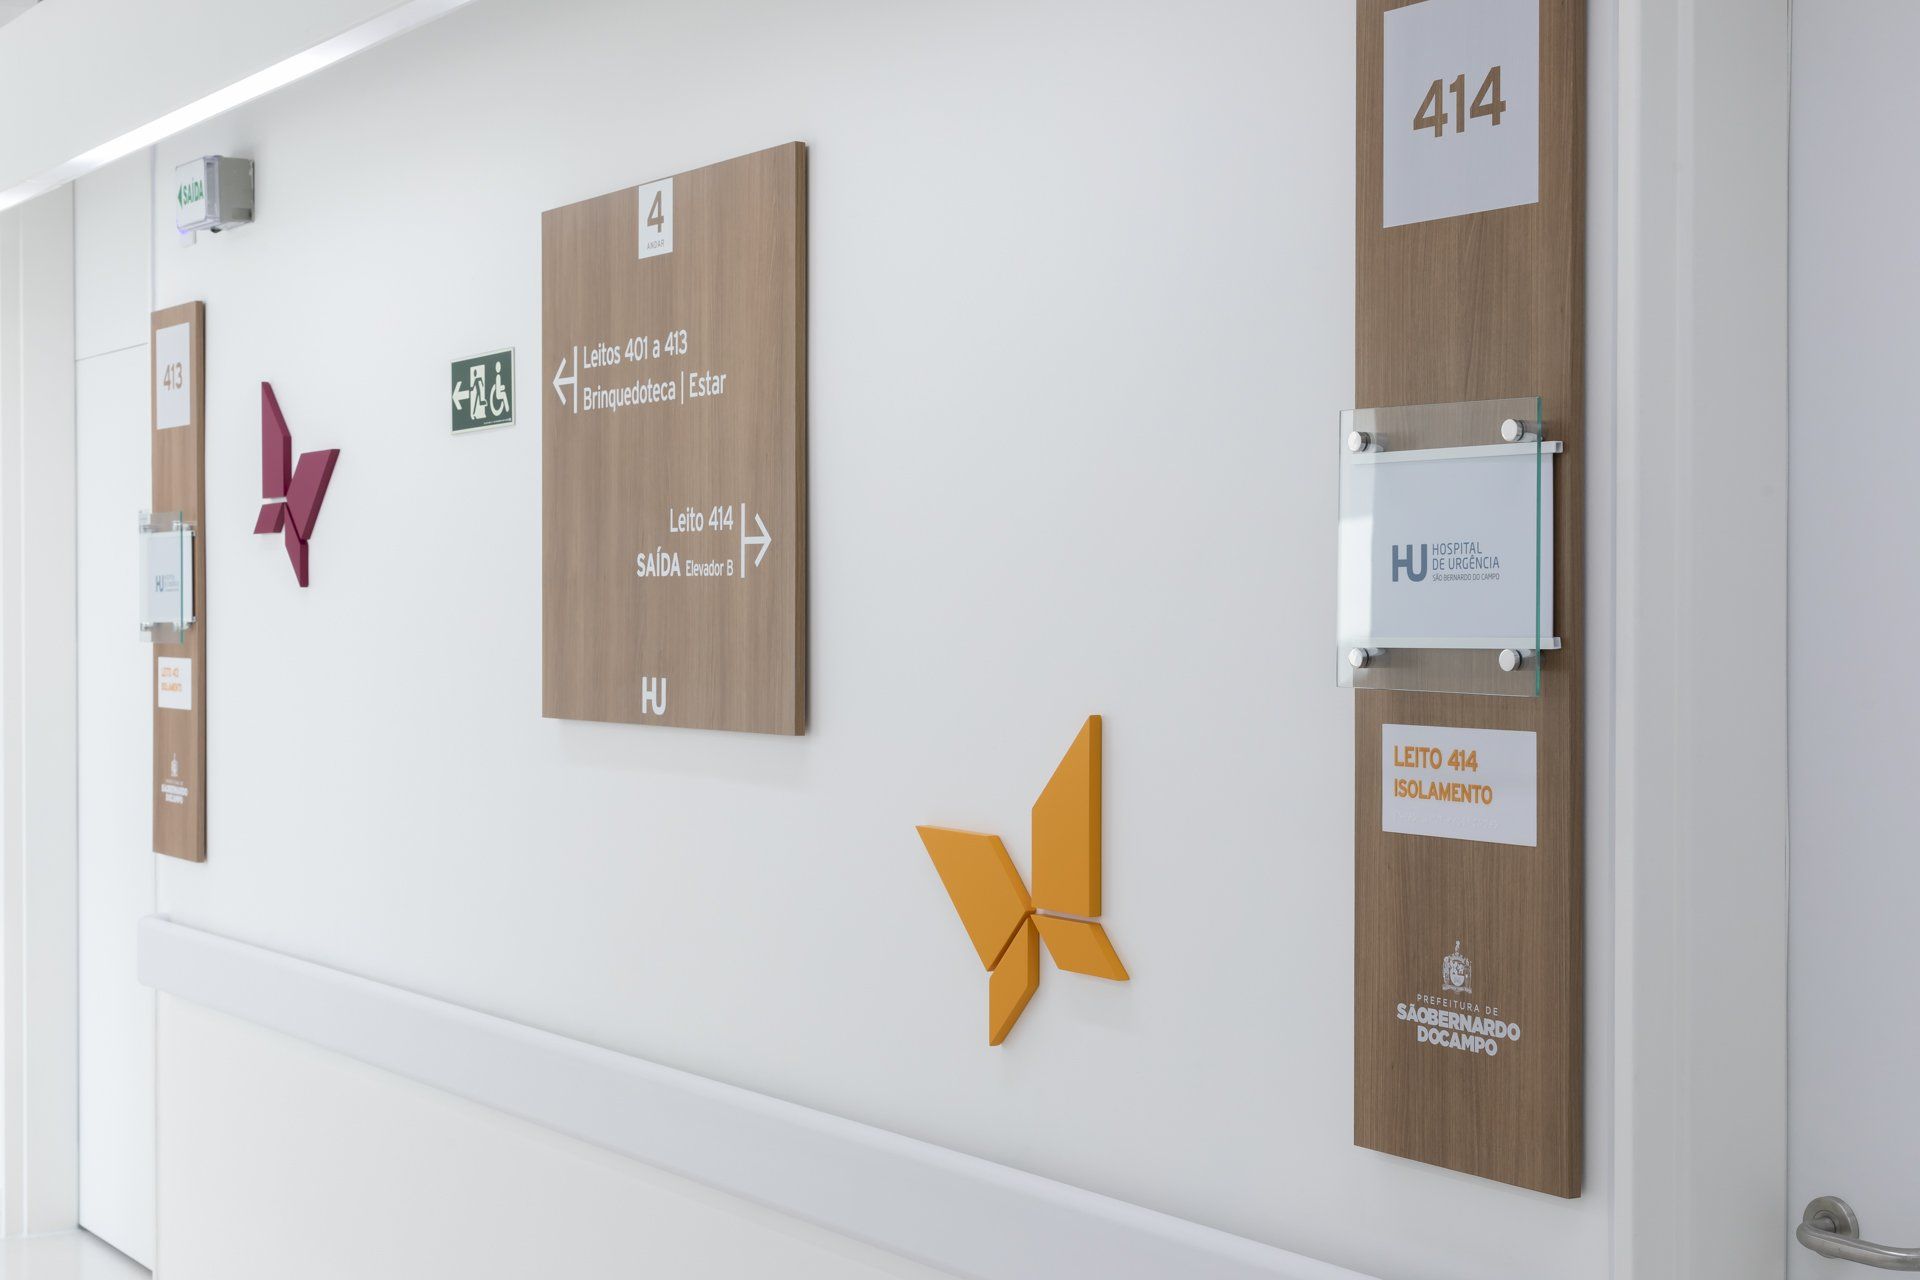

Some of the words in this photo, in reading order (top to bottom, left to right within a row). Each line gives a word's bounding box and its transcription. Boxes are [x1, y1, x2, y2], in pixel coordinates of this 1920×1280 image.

[1413, 65, 1506, 138] 414
[647, 190, 664, 233] 4
[647, 239, 664, 250] ANDAR
[583, 343, 621, 368] Leitos
[625, 336, 648, 362] 401
[653, 338, 660, 358] a
[664, 329, 688, 356] 413
[163, 362, 182, 391] 413
[583, 378, 676, 412] Brinquedoteca
[689, 370, 727, 398] Estar
[670, 507, 704, 533] Leito
[708, 505, 734, 531] 414
[636, 546, 681, 577] SAÍDA
[686, 560, 724, 576] Elevador
[726, 559, 734, 576] B
[1432, 541, 1482, 555] HOSPITAL
[1392, 543, 1428, 582] HU
[1432, 558, 1445, 571] DE
[1448, 555, 1500, 570] URGÊNCIA
[1432, 573, 1442, 582] SÃO
[1443, 573, 1471, 582] BERNARDO
[1472, 572, 1480, 581] DO
[1481, 572, 1500, 581] CAMPO
[642, 676, 667, 715] HU
[1394, 745, 1443, 769] LEITO
[1447, 749, 1478, 772] 414
[1394, 778, 1493, 805] ISOLAMENTO
[1416, 993, 1480, 1013] PREFEITURA
[1485, 1006, 1499, 1016] DE
